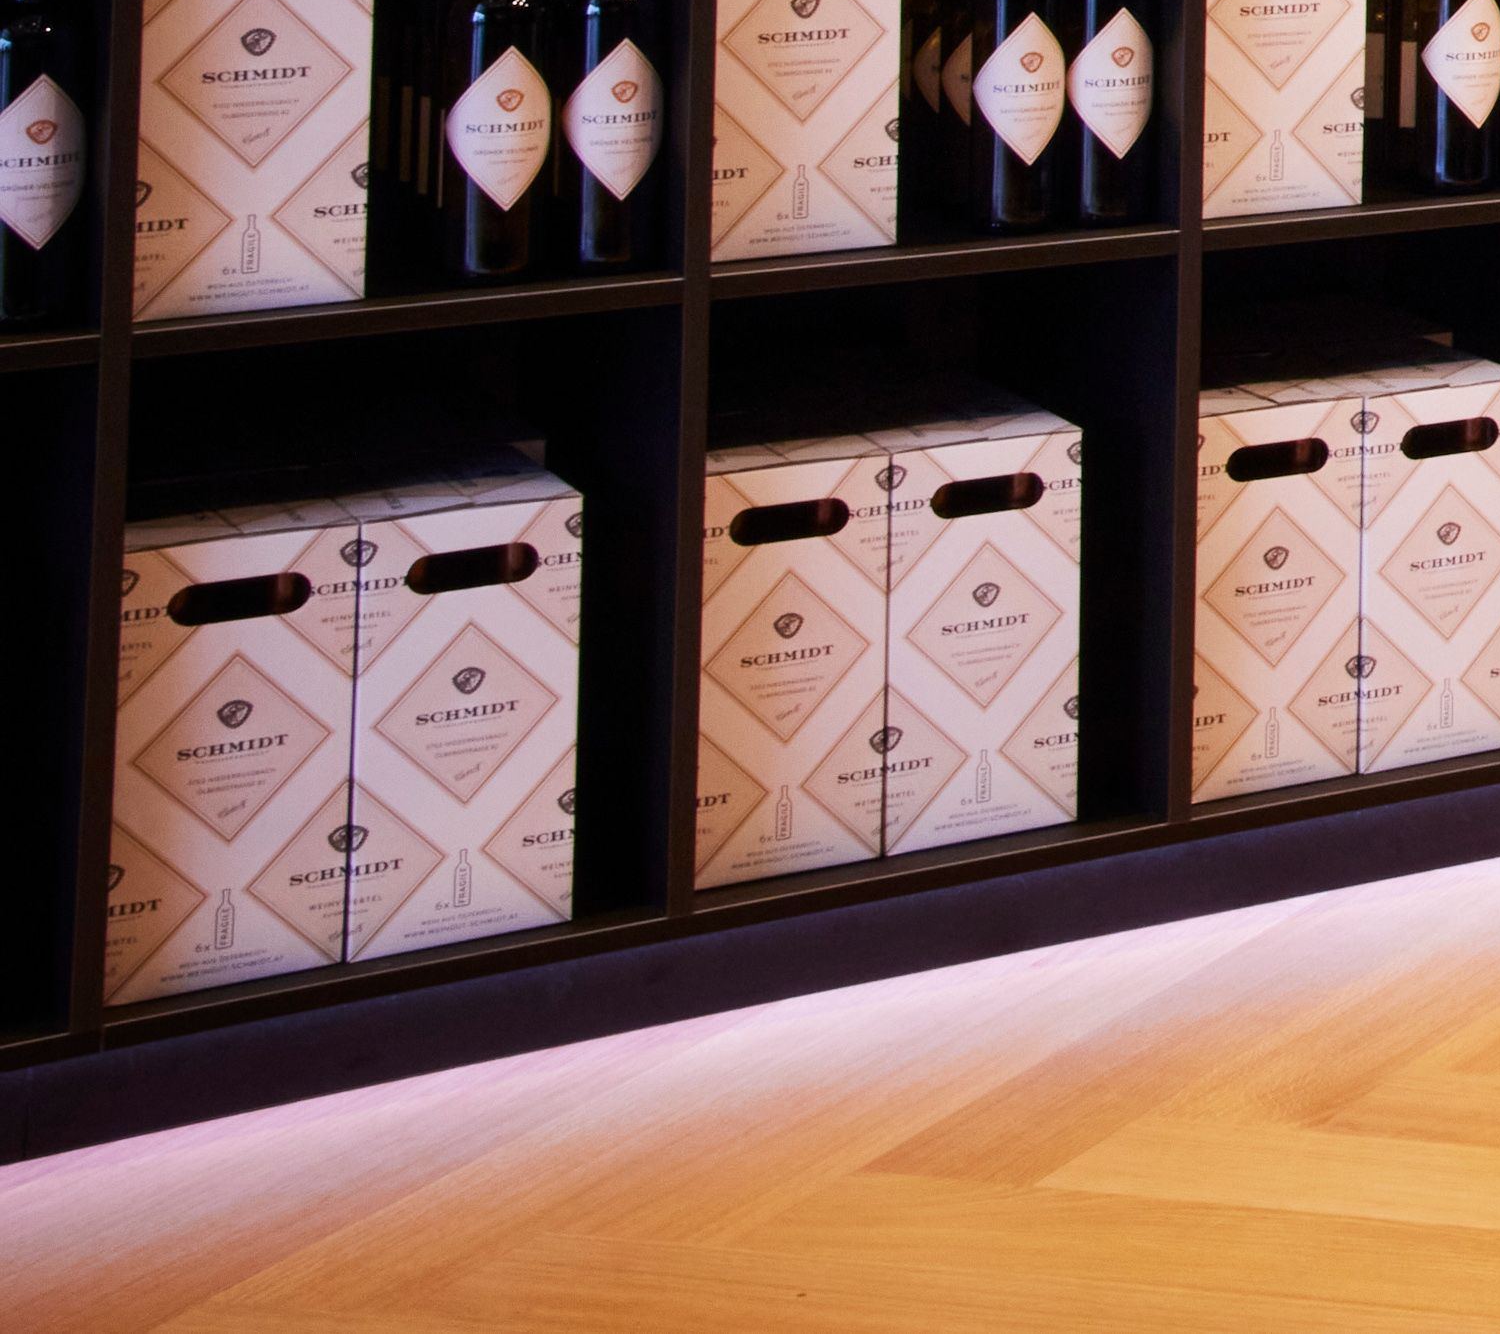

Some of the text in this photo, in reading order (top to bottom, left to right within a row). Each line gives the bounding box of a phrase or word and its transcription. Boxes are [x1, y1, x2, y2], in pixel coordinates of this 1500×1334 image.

[1238, 2, 1320, 18] SCHMIDT
[756, 28, 849, 46] SCHMIDT
[202, 67, 310, 84] SCHMIDT
[466, 119, 545, 133] SCHMIDT
[1409, 551, 1487, 572] SCHMIDT
[1233, 576, 1315, 598] SCHMIDT
[941, 613, 1030, 636] SCHMIDT
[738, 645, 833, 671] SCHMIDT
[415, 699, 520, 726] SCHMIDT
[177, 734, 288, 762] SCHMIDT
